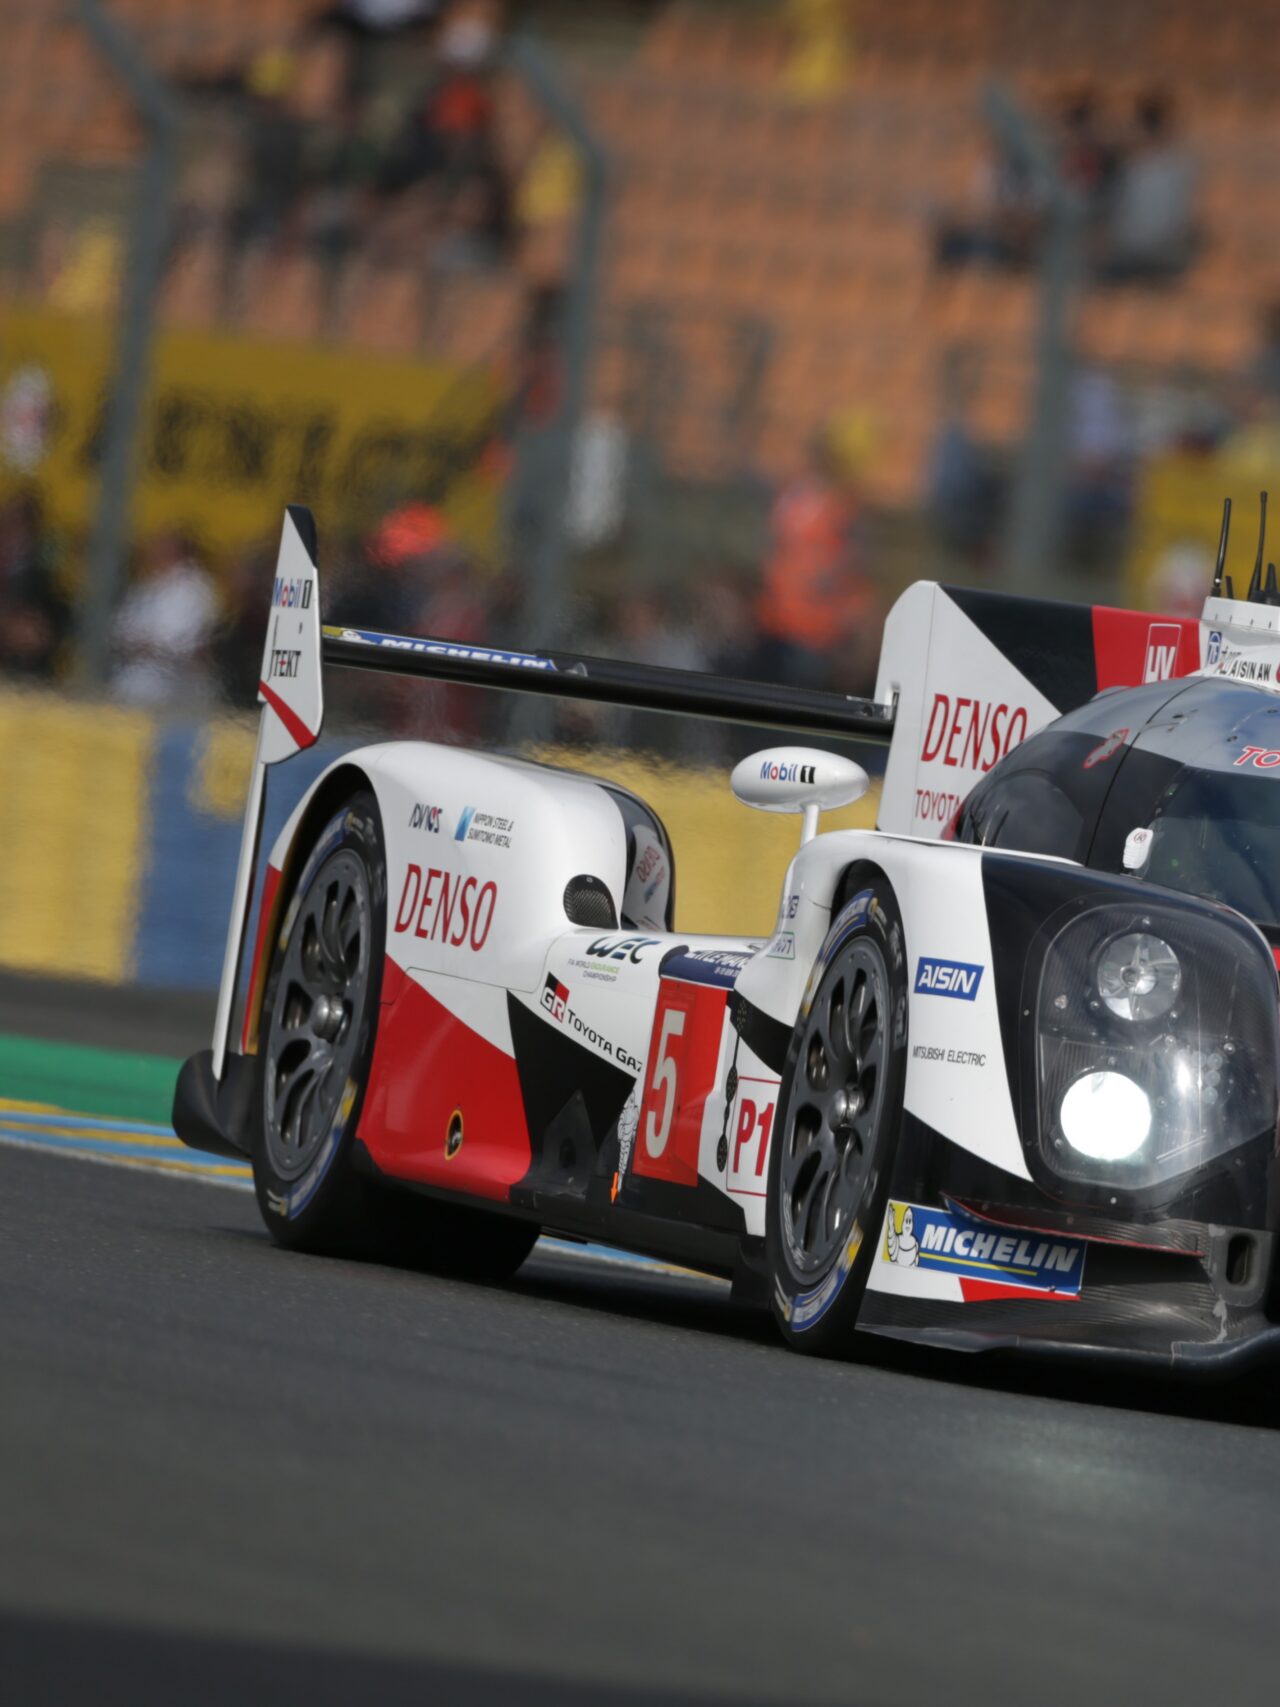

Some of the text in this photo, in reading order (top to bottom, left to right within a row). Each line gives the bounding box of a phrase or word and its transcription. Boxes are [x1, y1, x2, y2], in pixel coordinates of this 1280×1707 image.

[272, 578, 302, 608] Mobil
[266, 650, 301, 682] JTEKT
[380, 638, 549, 669] MICHELIN
[1229, 659, 1272, 682] AISIN AW
[921, 693, 1028, 773] DENSO
[760, 761, 816, 785] Mobil 1
[394, 863, 498, 952] DENSO
[585, 935, 662, 965] WEC
[918, 964, 977, 994] AISIN
[567, 1008, 613, 1057] TOYOTA
[947, 1049, 987, 1067] ELECTRIC
[646, 1008, 687, 1159] 5
[732, 1098, 775, 1177] P1
[921, 1223, 1080, 1273] MICHELIN
